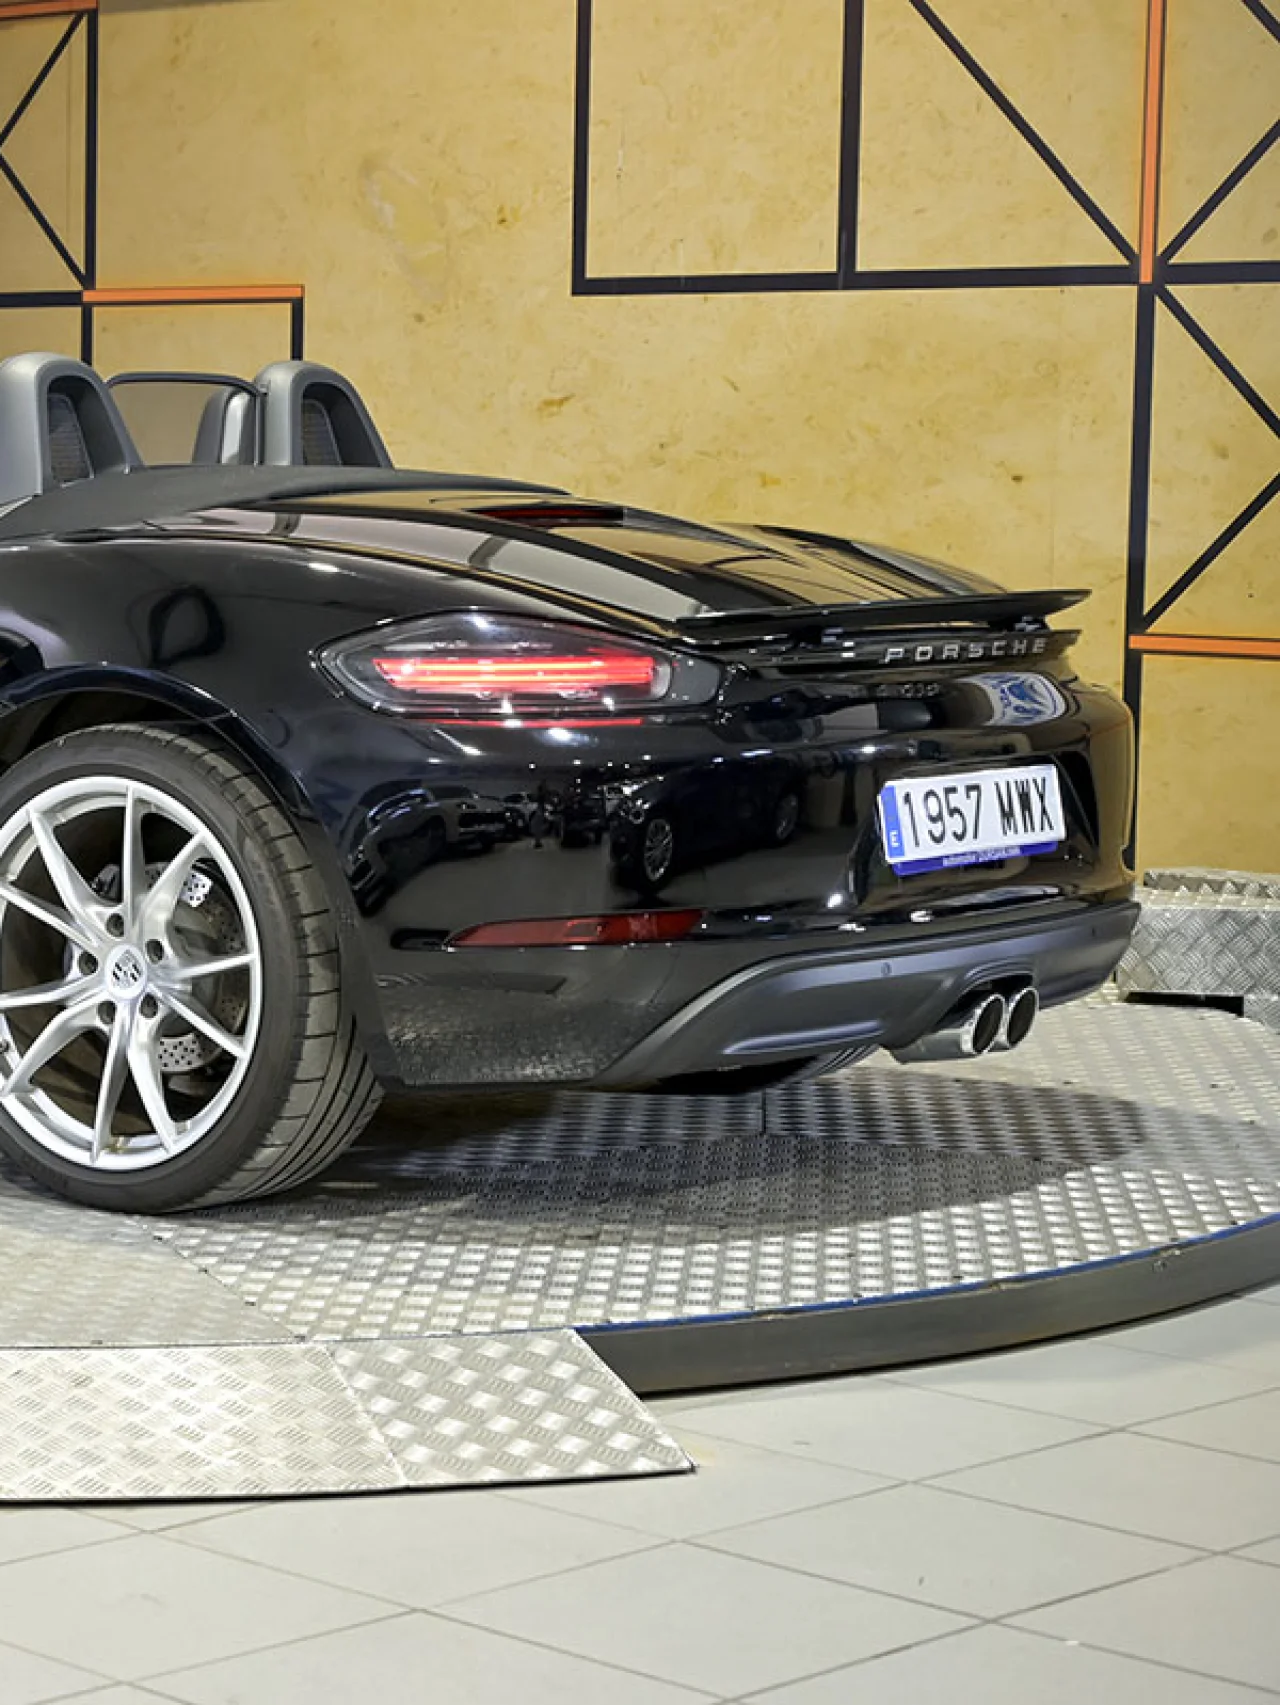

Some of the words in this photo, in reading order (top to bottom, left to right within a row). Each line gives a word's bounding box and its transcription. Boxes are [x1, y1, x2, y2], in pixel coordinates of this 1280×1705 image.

[883, 638, 1047, 663] PORSCHE
[902, 784, 983, 848] 1957
[993, 776, 1055, 837] MWX
[889, 831, 901, 848] E
